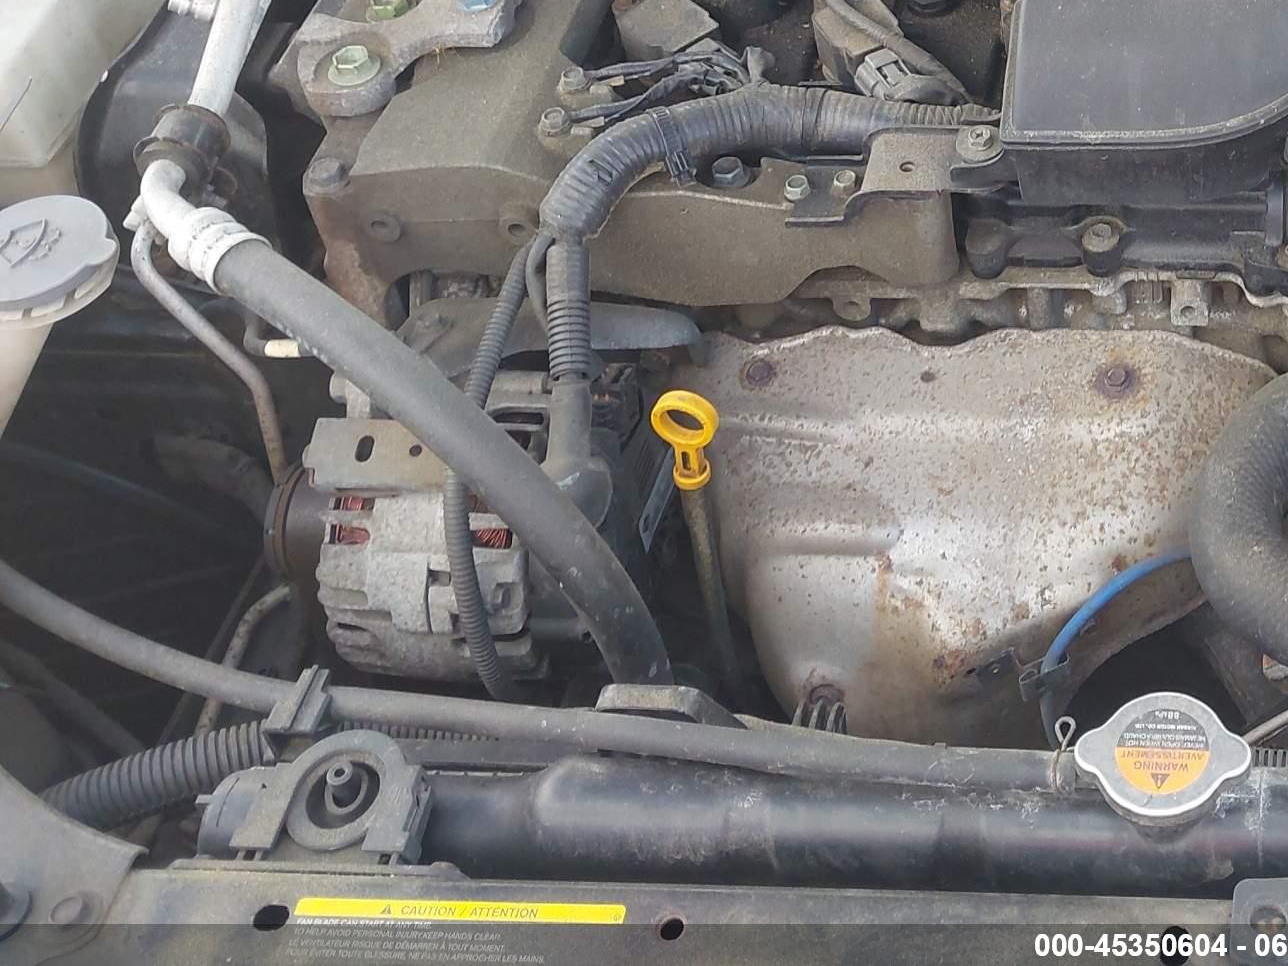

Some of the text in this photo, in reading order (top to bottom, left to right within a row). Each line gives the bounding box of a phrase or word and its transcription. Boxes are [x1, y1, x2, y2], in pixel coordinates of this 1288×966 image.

[1133, 760, 1189, 772] WARNING
[400, 905, 457, 917] CAUTION
[470, 907, 539, 919] ATTENTION
[396, 921, 413, 929] ANY
[294, 926, 305, 935] TO
[305, 927, 326, 936] HELP
[327, 928, 351, 937] AVOID
[353, 929, 394, 938] PERSONAL
[445, 932, 472, 940] HANDS
[301, 939, 350, 947] VENTILATEUR
[383, 941, 394, 949] DE
[448, 943, 468, 952] TOUT
[451, 953, 501, 962] APPROCHER
[501, 955, 518, 963] LES
